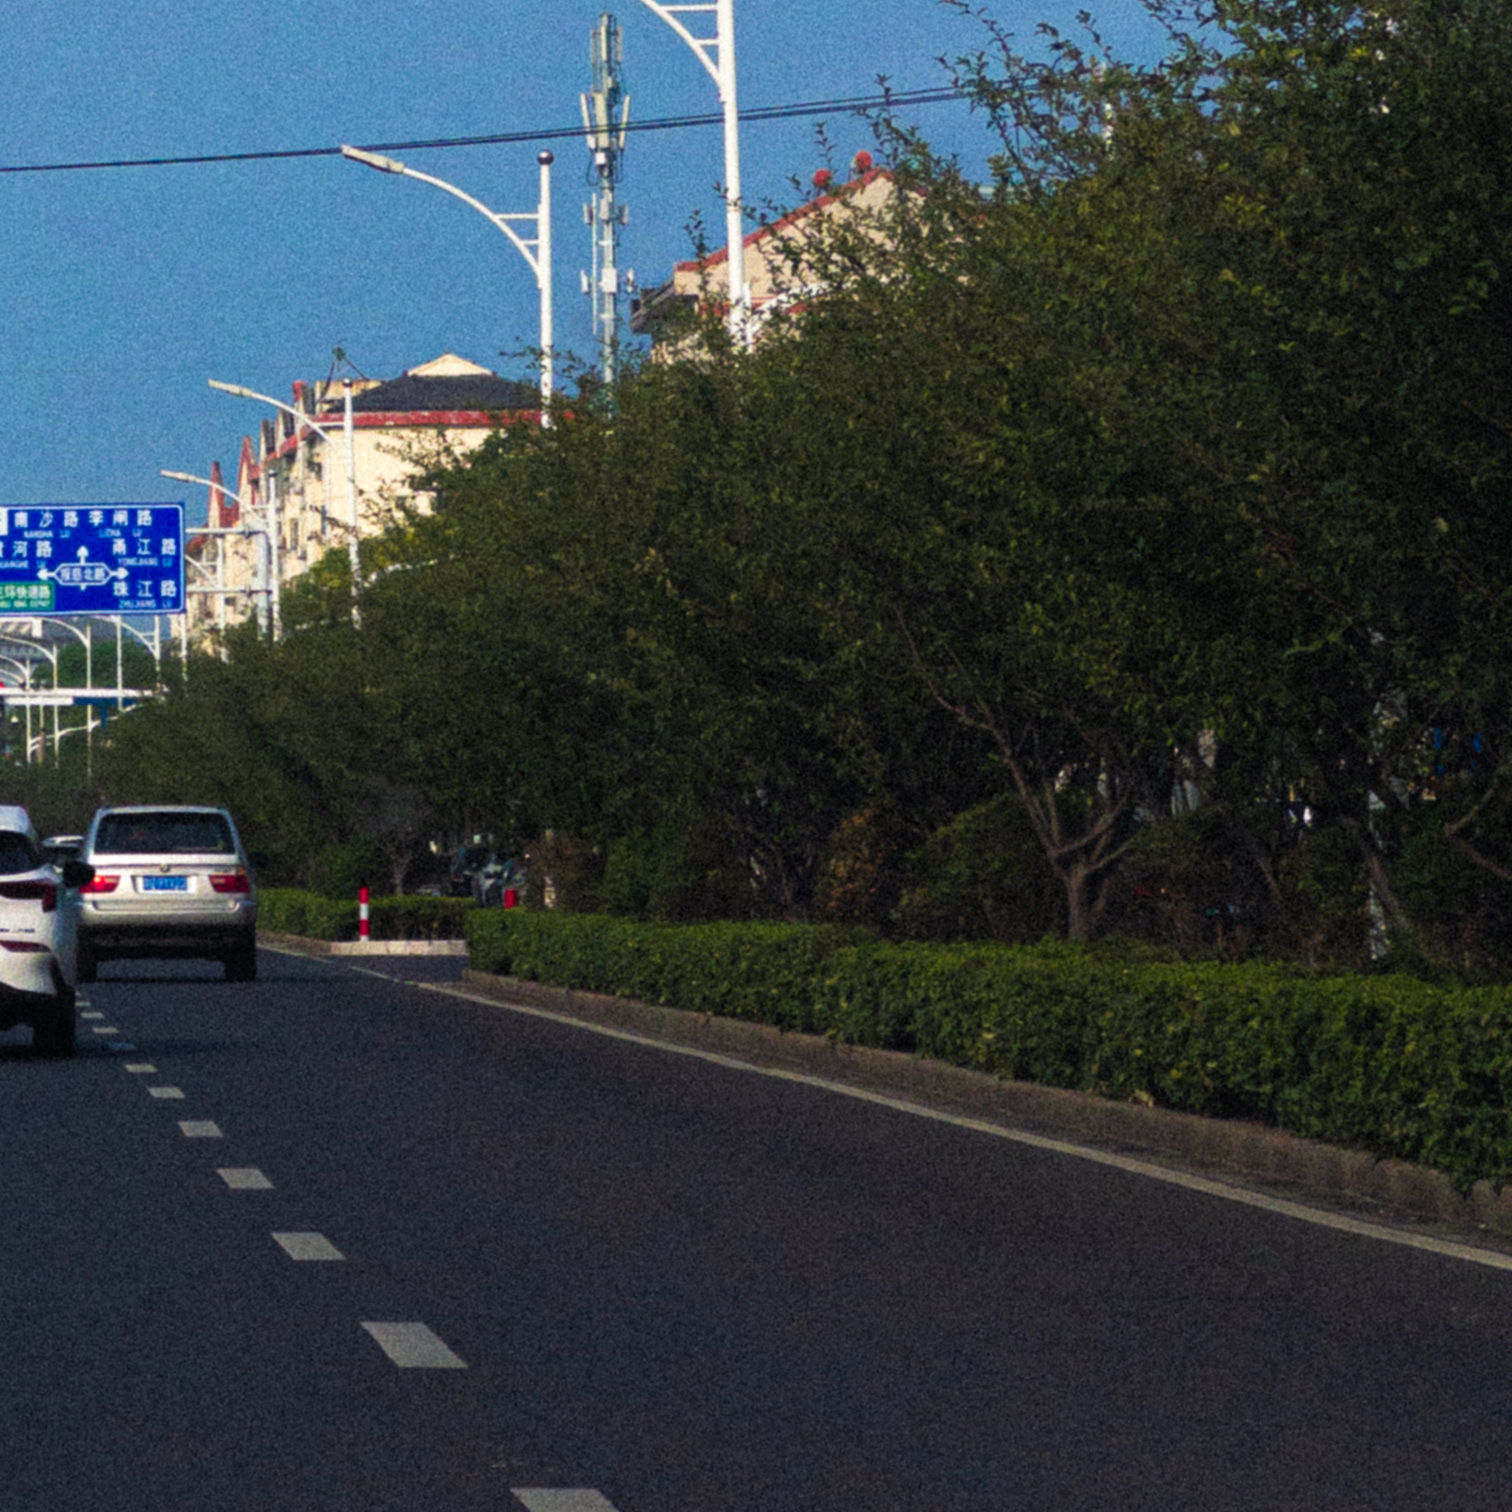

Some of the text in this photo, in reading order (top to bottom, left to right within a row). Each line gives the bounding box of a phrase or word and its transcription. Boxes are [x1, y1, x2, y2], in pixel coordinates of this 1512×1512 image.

[14, 511, 79, 528] 南沙路
[89, 510, 152, 527] 李闸路
[99, 528, 121, 538] LIZHA
[112, 538, 176, 555] 甬江路
[113, 580, 176, 597] 珠江路
